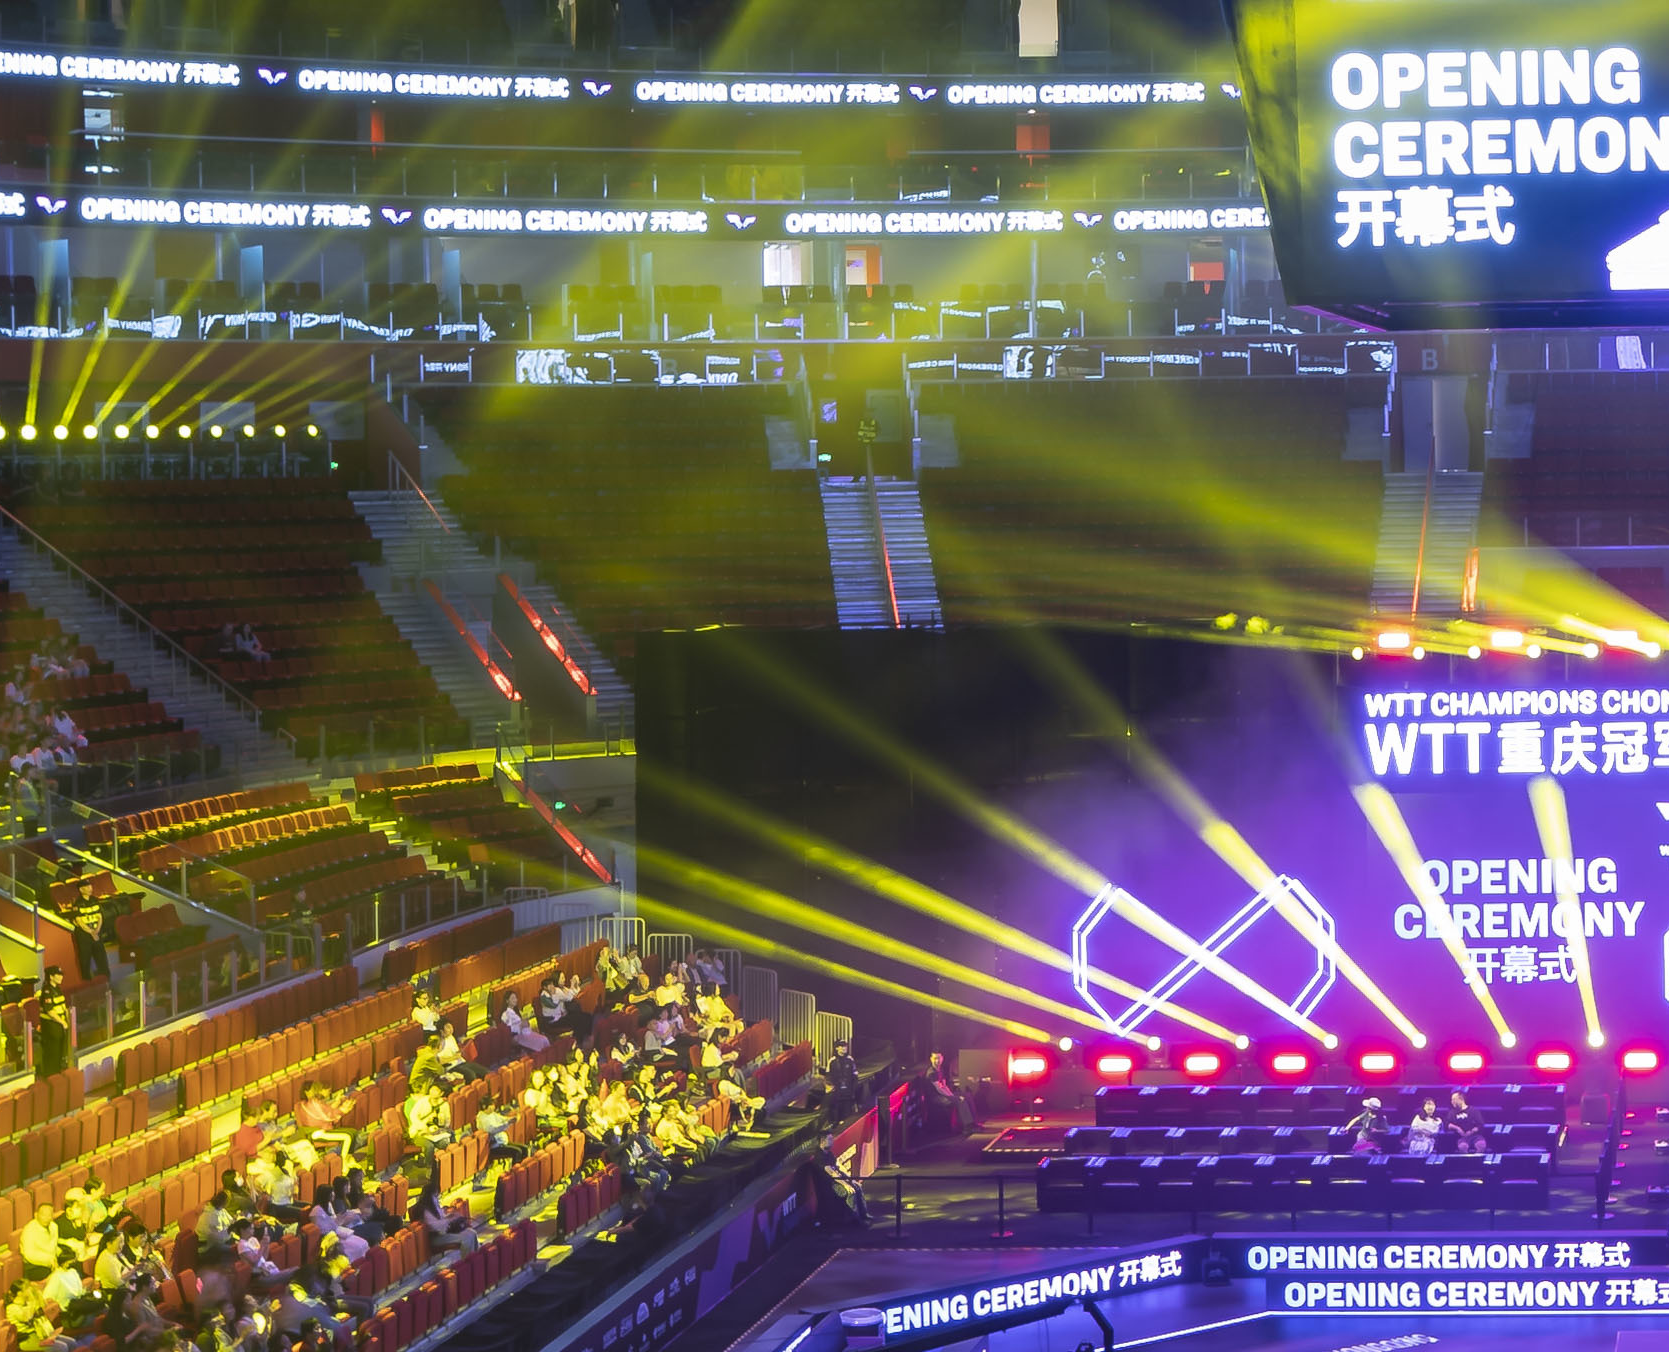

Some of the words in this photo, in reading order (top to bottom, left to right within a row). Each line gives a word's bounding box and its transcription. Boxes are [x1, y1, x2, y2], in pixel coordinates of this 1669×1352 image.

[59, 55, 182, 84] CEREMONY
[1331, 48, 1642, 111] OPENING
[636, 81, 728, 102] OPENING
[730, 82, 845, 104] CEREMONY
[947, 84, 1037, 105] OPENING
[1039, 83, 1151, 104] CEREMONY
[80, 197, 182, 223] OPENING
[183, 201, 310, 226] CEREMONY
[785, 212, 883, 234] OPENING
[884, 211, 1006, 234] CEREMONY
[1113, 208, 1209, 231] OPENING
[1334, 188, 1516, 247] 开幕式
[1364, 692, 1427, 718] WTT
[1430, 690, 1598, 716] CHAMPIONS
[1419, 857, 1618, 896] OPENING
[1394, 900, 1646, 940] CEREMONY
[1462, 945, 1578, 985] 开幕式
[1247, 1245, 1378, 1271] OPENING
[1383, 1244, 1548, 1270] CEREMONY
[1554, 1241, 1631, 1269] 开幕式
[972, 1265, 1115, 1317] CEREMONY
[1118, 1250, 1183, 1288] 开幕式
[1284, 1280, 1420, 1308] OPENING
[1426, 1280, 1599, 1308] CEREMONY
